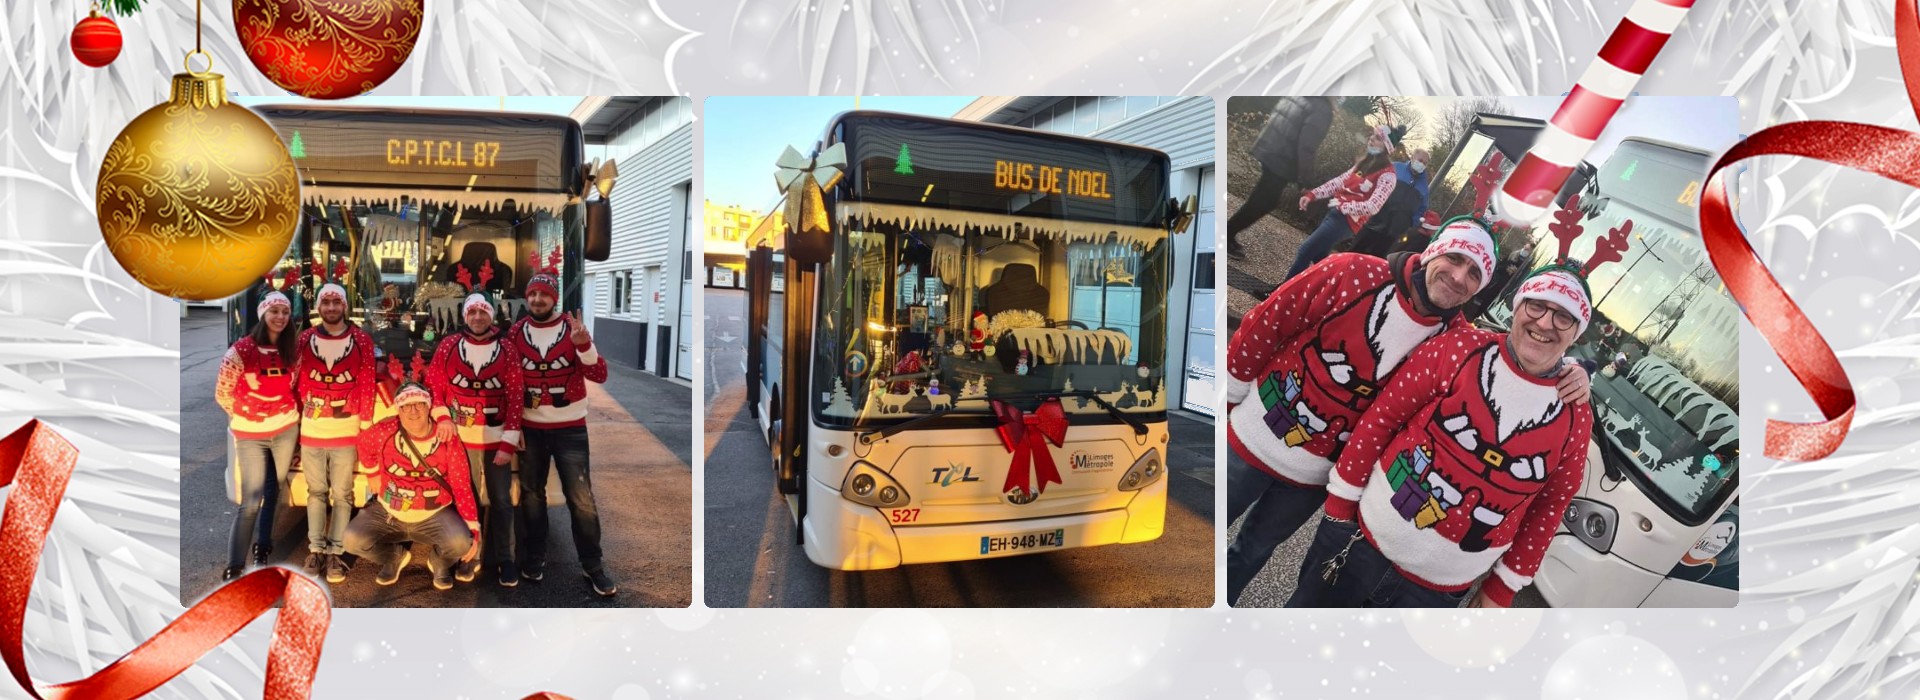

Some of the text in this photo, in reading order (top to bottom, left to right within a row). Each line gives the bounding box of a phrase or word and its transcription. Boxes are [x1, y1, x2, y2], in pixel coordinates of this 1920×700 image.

[474, 141, 501, 167] 87
[995, 159, 1112, 199] BUS DE NOEL
[892, 508, 920, 523] 527
[989, 532, 1056, 552] EH-948-MZ
